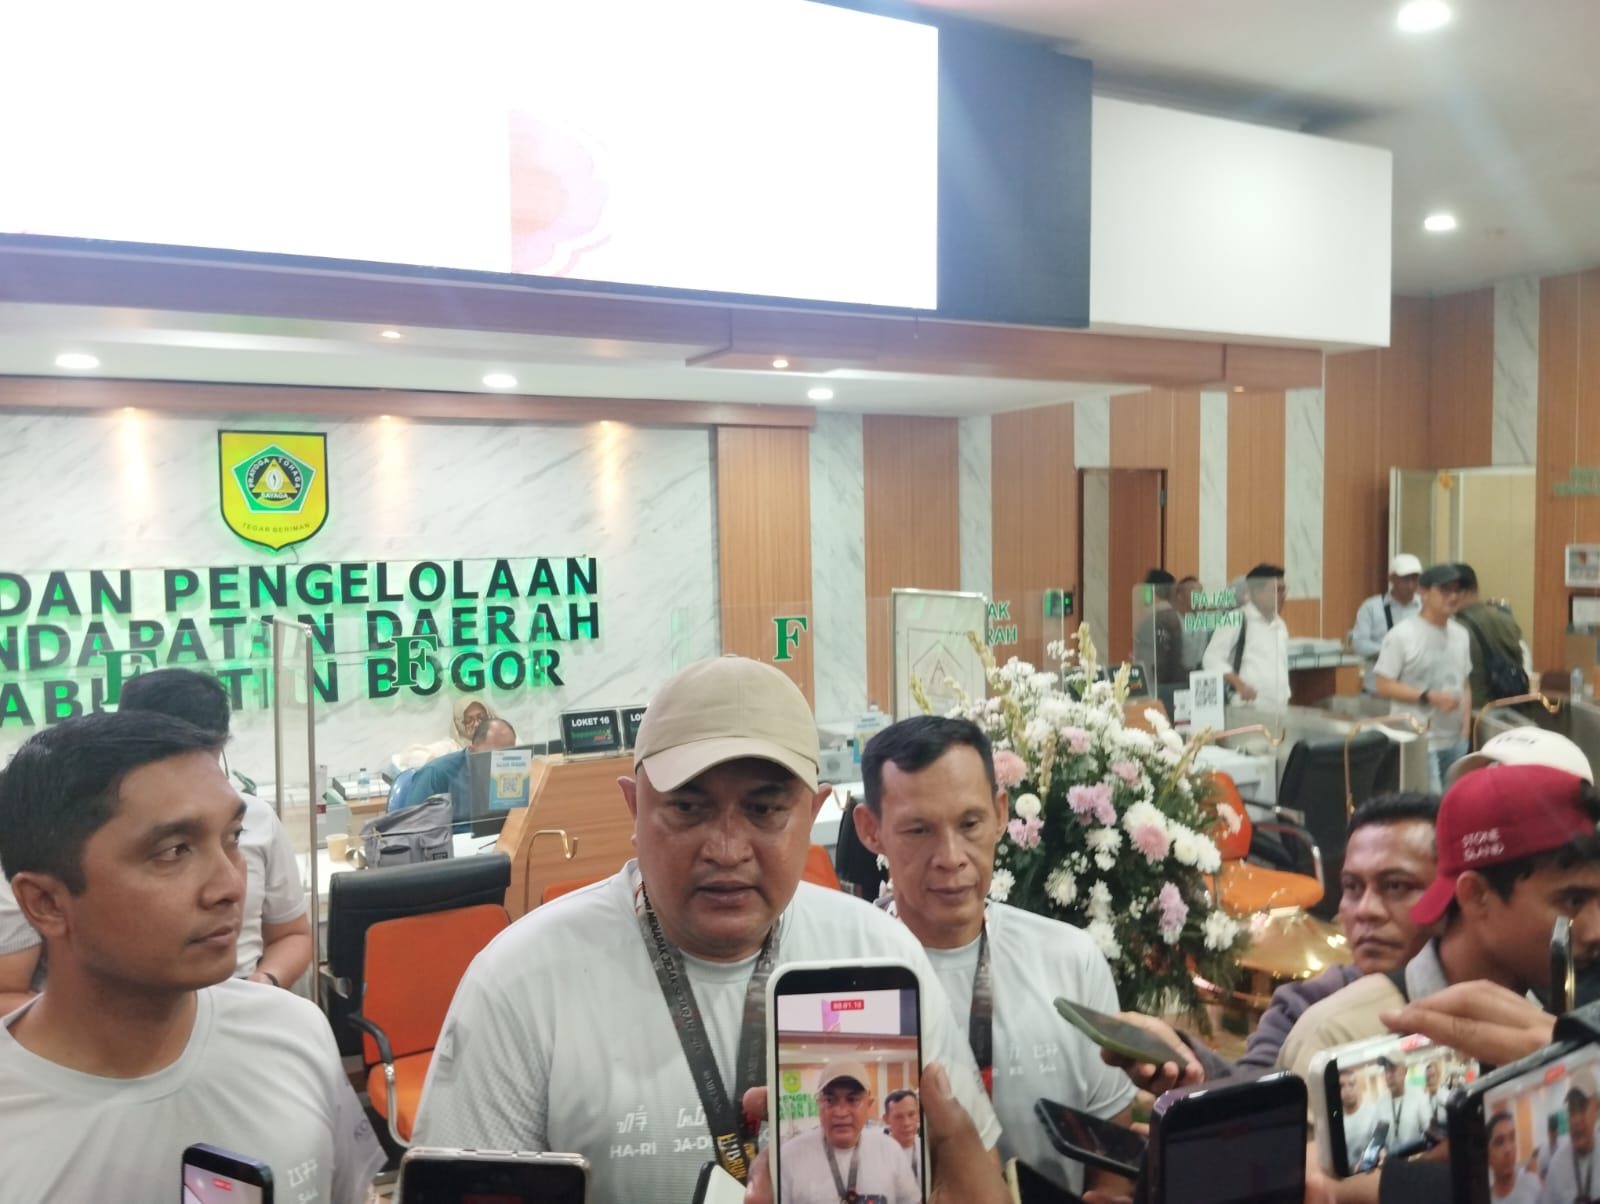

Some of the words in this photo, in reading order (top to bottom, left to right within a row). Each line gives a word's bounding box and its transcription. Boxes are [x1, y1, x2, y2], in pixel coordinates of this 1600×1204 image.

[164, 557, 598, 613] PENGELOLAAN
[366, 601, 600, 651] DAERAH
[772, 615, 808, 661] F
[366, 649, 565, 700] BOGOR
[390, 633, 439, 689] F
[571, 716, 599, 727] LOKET
[609, 1141, 657, 1159] HA-RI
